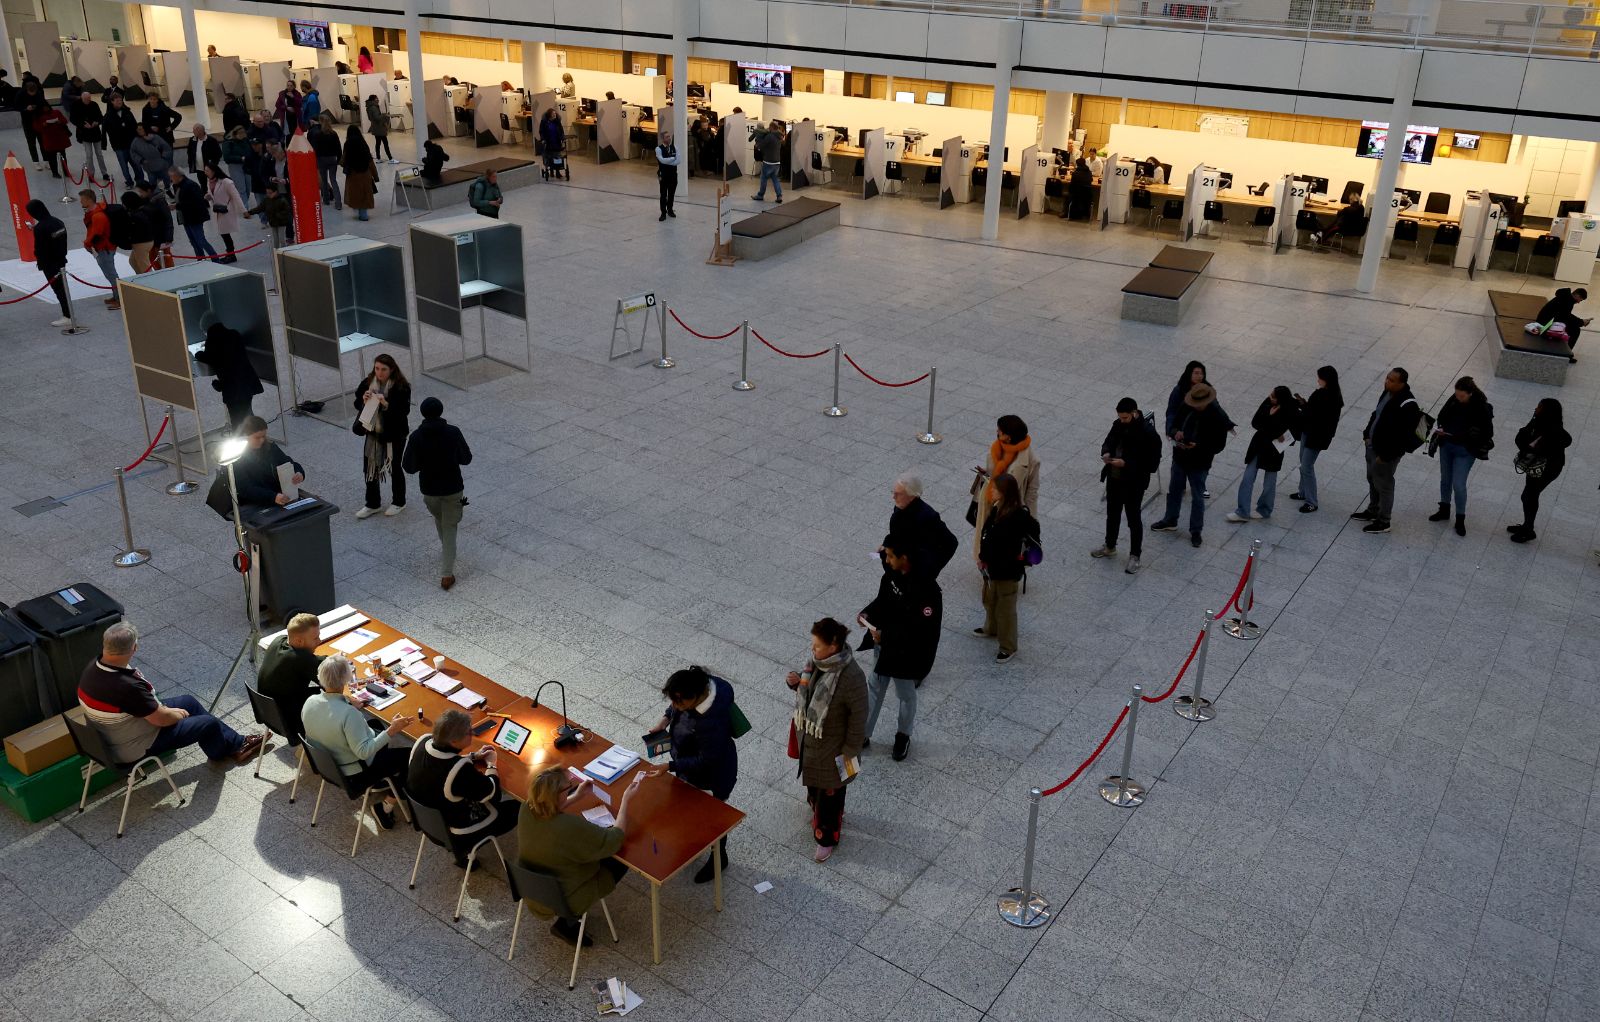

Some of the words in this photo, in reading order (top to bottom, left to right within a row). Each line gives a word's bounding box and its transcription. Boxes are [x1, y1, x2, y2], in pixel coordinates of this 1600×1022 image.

[444, 90, 452, 98] 10
[746, 125, 755, 133] 15
[815, 133, 824, 141] 16
[960, 149, 969, 158] 18
[1036, 158, 1048, 167] 19
[1115, 167, 1129, 177] 20
[1202, 178, 1214, 187] 21
[1290, 187, 1304, 197] 22
